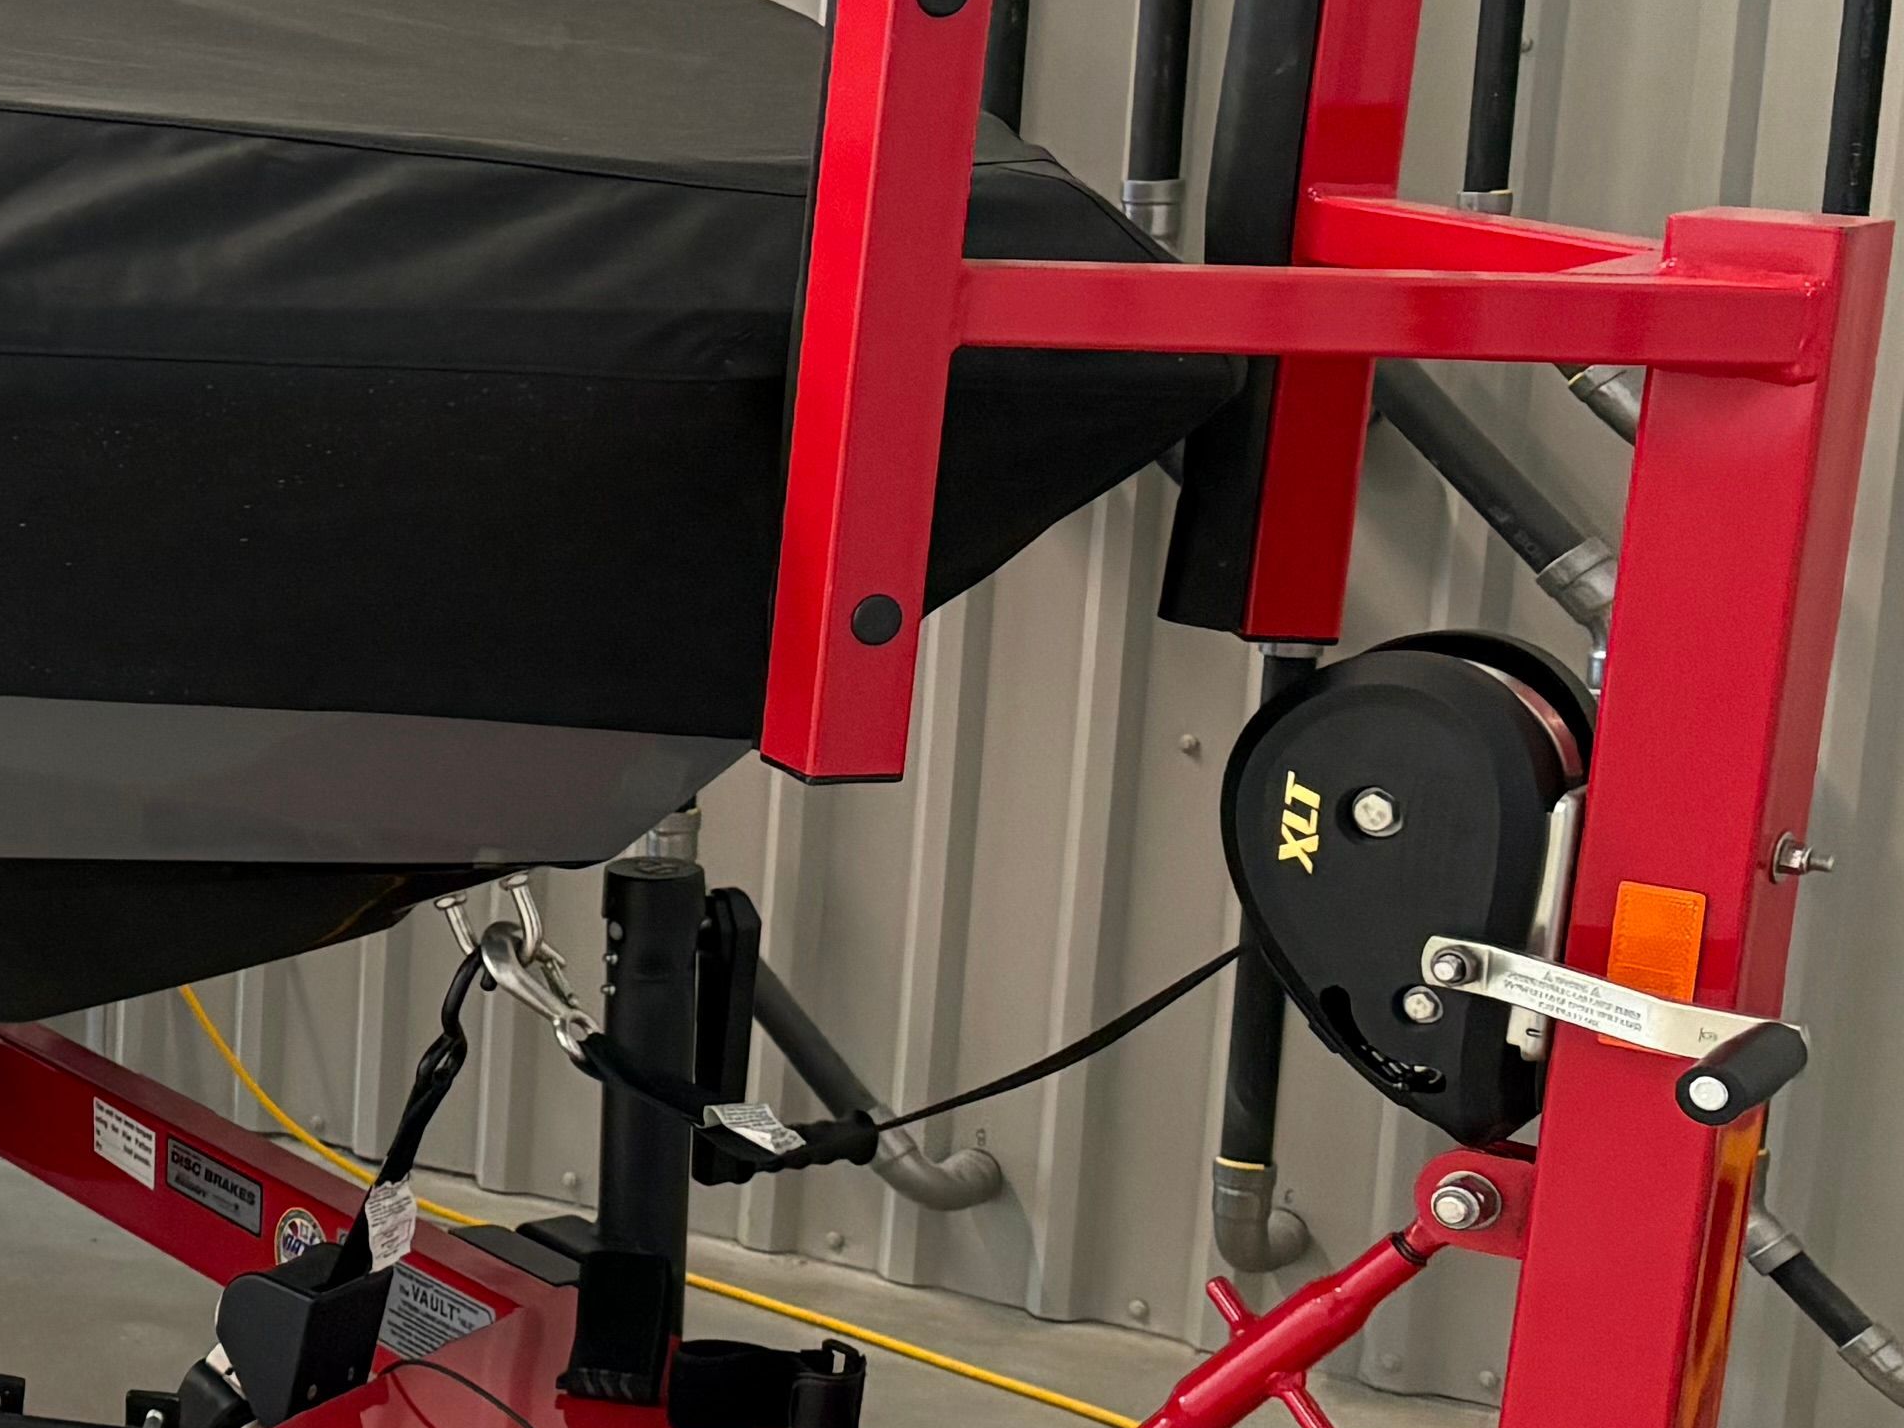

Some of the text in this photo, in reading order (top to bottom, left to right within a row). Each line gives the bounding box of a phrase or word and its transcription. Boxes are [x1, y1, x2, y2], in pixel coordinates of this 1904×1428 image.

[1278, 770, 1321, 875] XLT
[171, 1150, 201, 1177] DISC
[204, 1167, 256, 1206] BRAKES
[411, 1283, 460, 1322] VAULT
